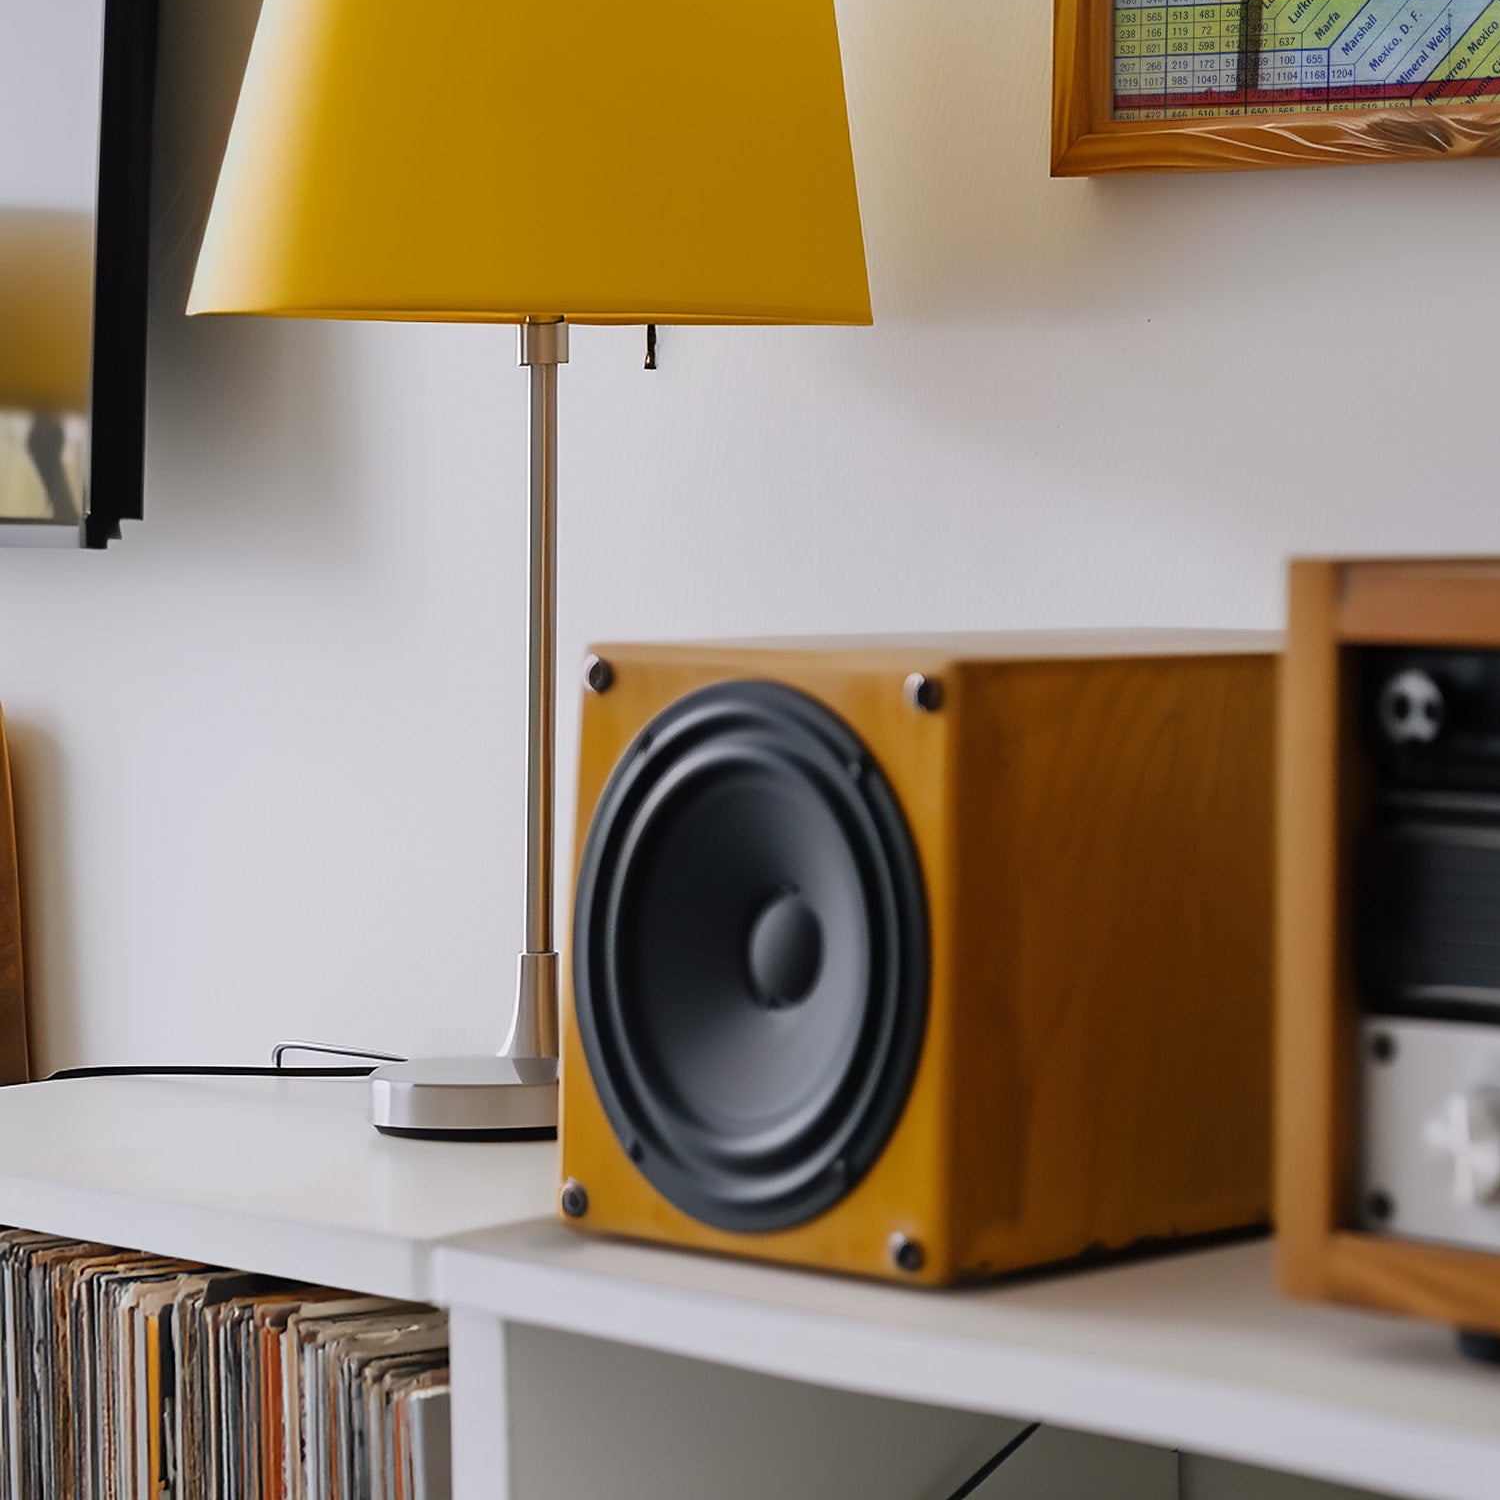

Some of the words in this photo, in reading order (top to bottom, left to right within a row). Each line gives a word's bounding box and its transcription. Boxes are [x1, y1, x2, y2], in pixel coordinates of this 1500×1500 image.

[1172, 9, 1189, 21] 513
[1199, 8, 1216, 19] 483
[1313, 11, 1341, 41] Marfa
[1120, 29, 1136, 40] 238
[1172, 26, 1189, 36] 119
[1201, 25, 1213, 35] 72
[1341, 13, 1378, 57] Marshall
[1368, 37, 1403, 72] Mexico,
[1399, 22, 1414, 35] D.
[1410, 11, 1423, 23] F.
[1119, 45, 1136, 55] 532
[1172, 41, 1188, 52] 583
[1199, 39, 1215, 51] 598
[1278, 37, 1296, 47] 637
[1396, 50, 1430, 88] Mineral
[1426, 23, 1452, 52] Wells
[1119, 63, 1136, 73] 207
[1145, 61, 1162, 72] 266
[1172, 59, 1188, 70] 219
[1199, 58, 1215, 69] 172
[1279, 55, 1296, 65] 100
[1306, 54, 1323, 64] 655
[1423, 57, 1471, 106] Monterrey,
[1466, 20, 1500, 55] Mexico
[1118, 77, 1139, 88] 1219
[1144, 76, 1165, 87] 1017
[1171, 75, 1188, 86] 985
[1196, 74, 1218, 85] 1049
[1277, 71, 1298, 82] 1104
[1304, 70, 1326, 80] 1168
[1331, 68, 1353, 79] 1204
